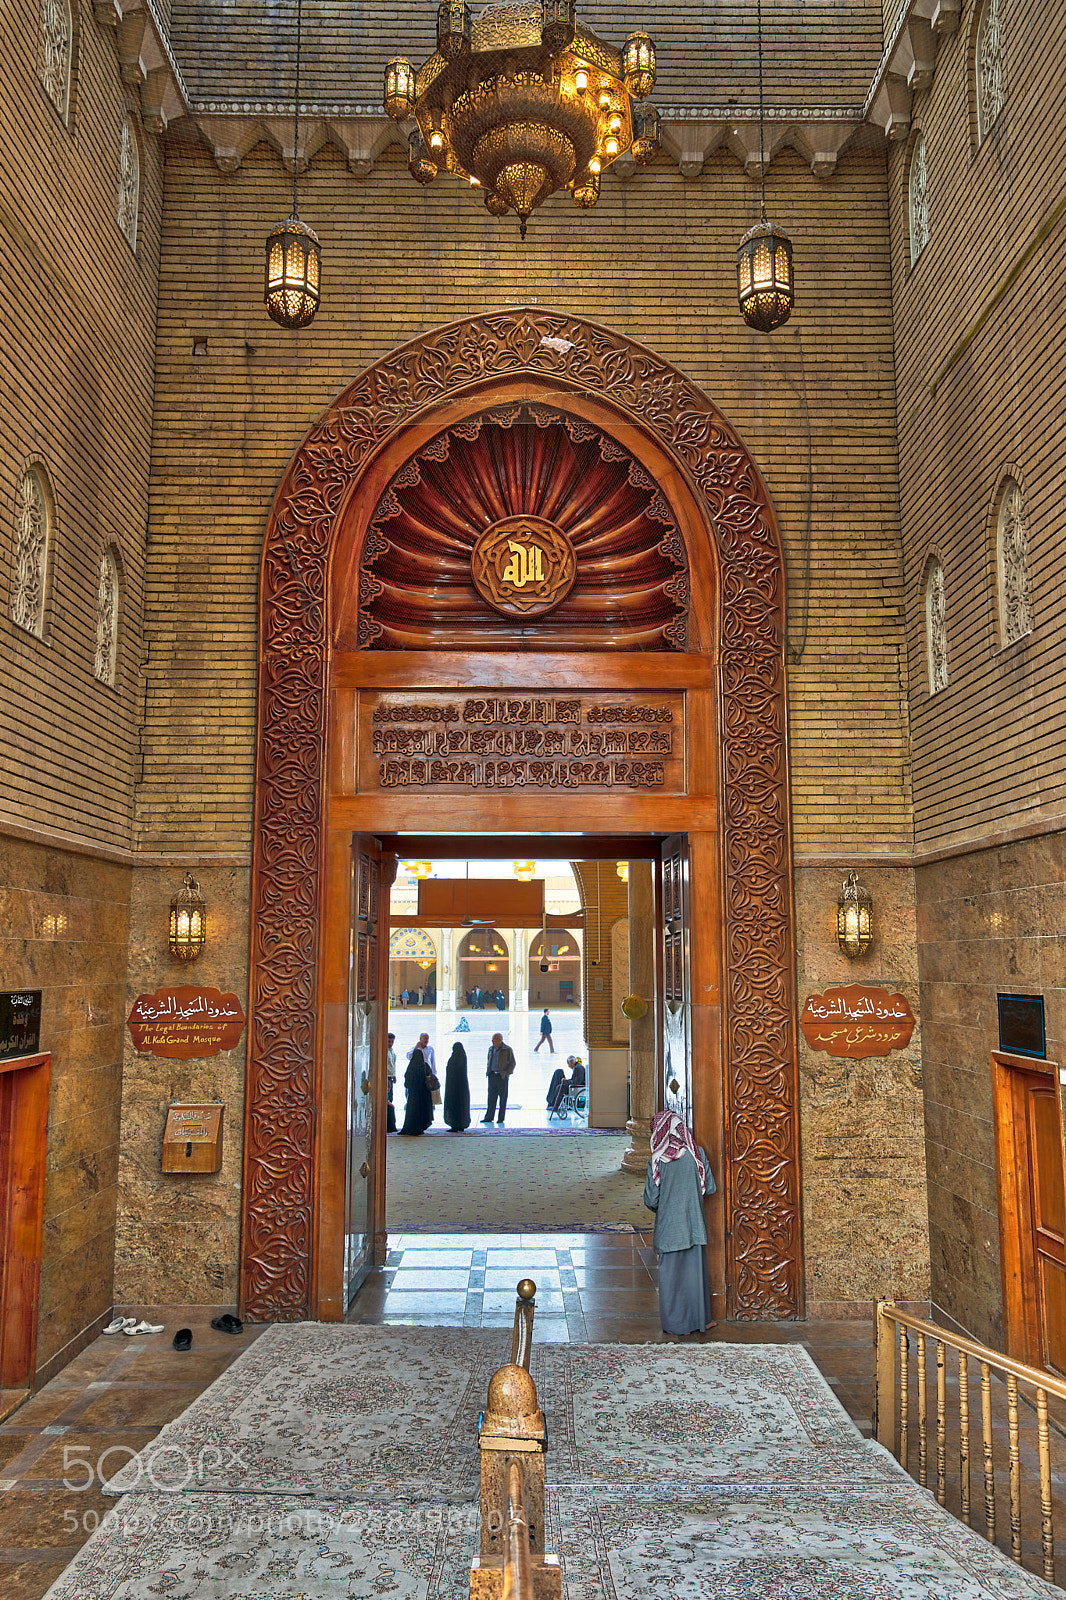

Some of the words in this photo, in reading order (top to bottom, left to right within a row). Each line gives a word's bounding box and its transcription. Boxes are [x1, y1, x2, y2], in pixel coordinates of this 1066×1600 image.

[502, 539, 545, 588] الله
[138, 1023, 154, 1032] The
[155, 1023, 175, 1034] Legal
[176, 1023, 214, 1032] Boundaries
[217, 1023, 228, 1031] of
[166, 1035, 190, 1044] Grand
[192, 1035, 222, 1046] Mosque
